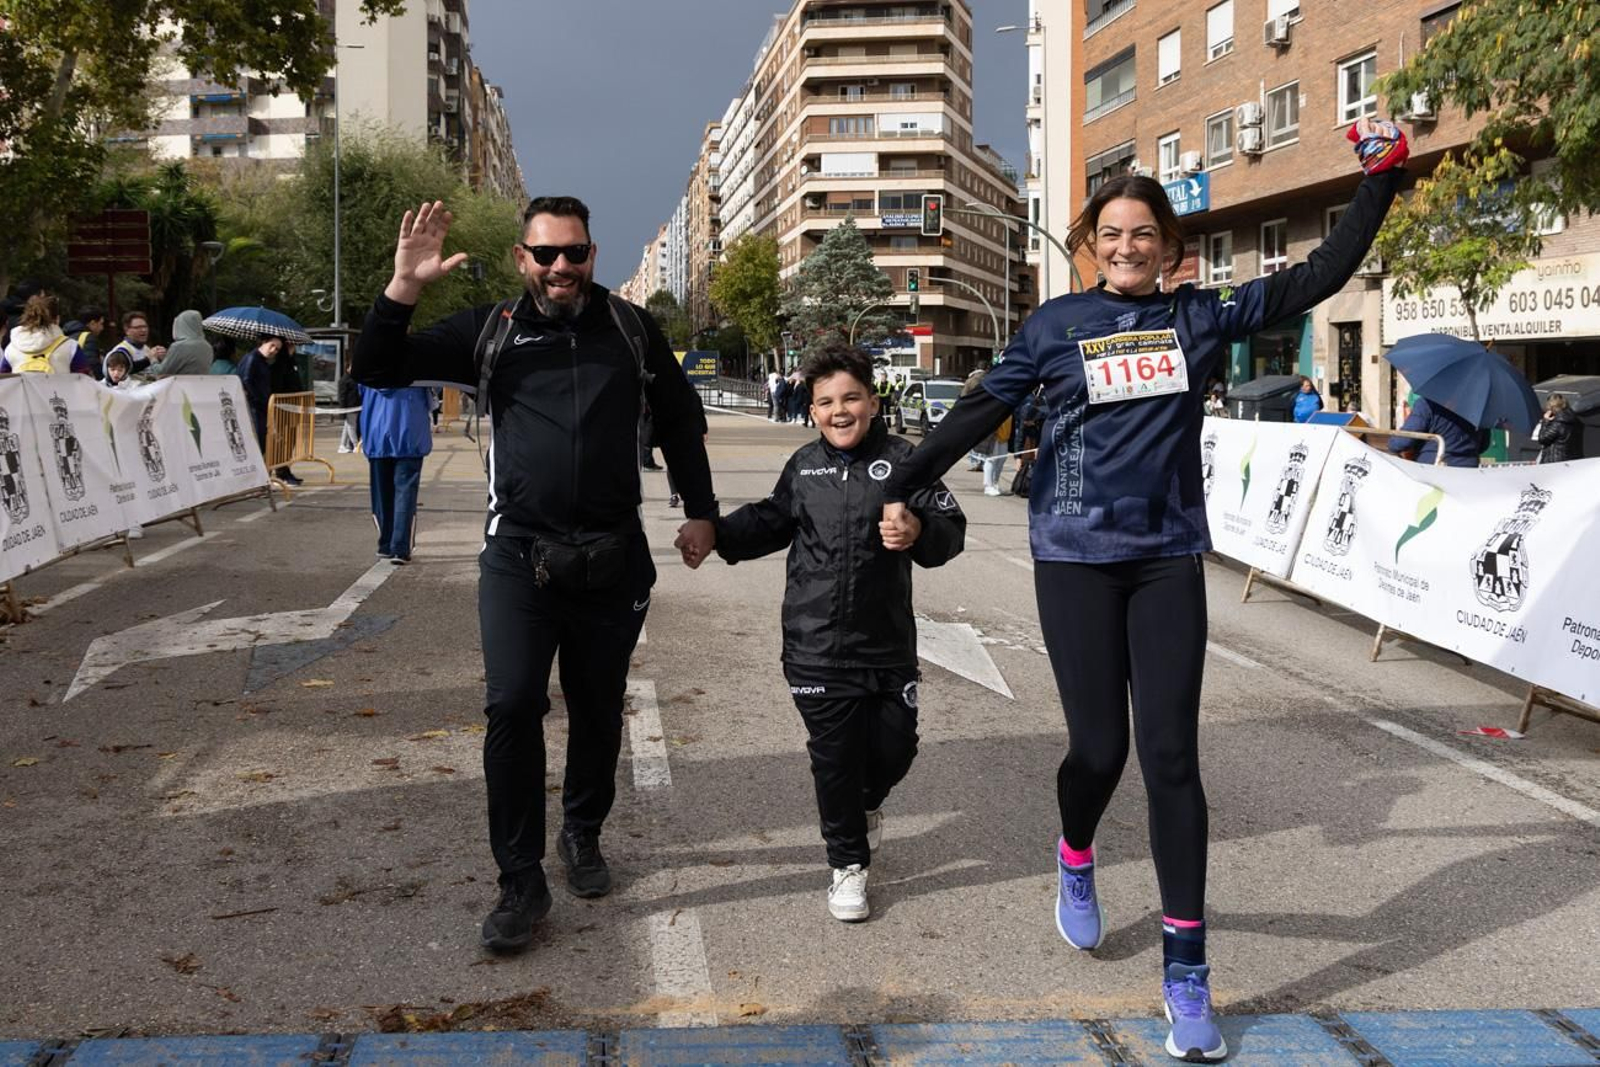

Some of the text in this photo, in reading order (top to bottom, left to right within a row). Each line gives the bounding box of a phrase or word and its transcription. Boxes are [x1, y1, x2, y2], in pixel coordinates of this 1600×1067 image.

[1396, 301, 1417, 320] 958
[1422, 299, 1445, 319] 650
[1509, 290, 1538, 313] 603
[1543, 287, 1575, 311] 045
[1431, 325, 1478, 337] DISPONIBL
[1084, 341, 1106, 355] XXV
[1116, 340, 1136, 349] gran
[1097, 353, 1174, 386] 1164
[1069, 480, 1080, 498] DE
[1456, 609, 1494, 632] CIUDAD
[1493, 620, 1507, 637] DE
